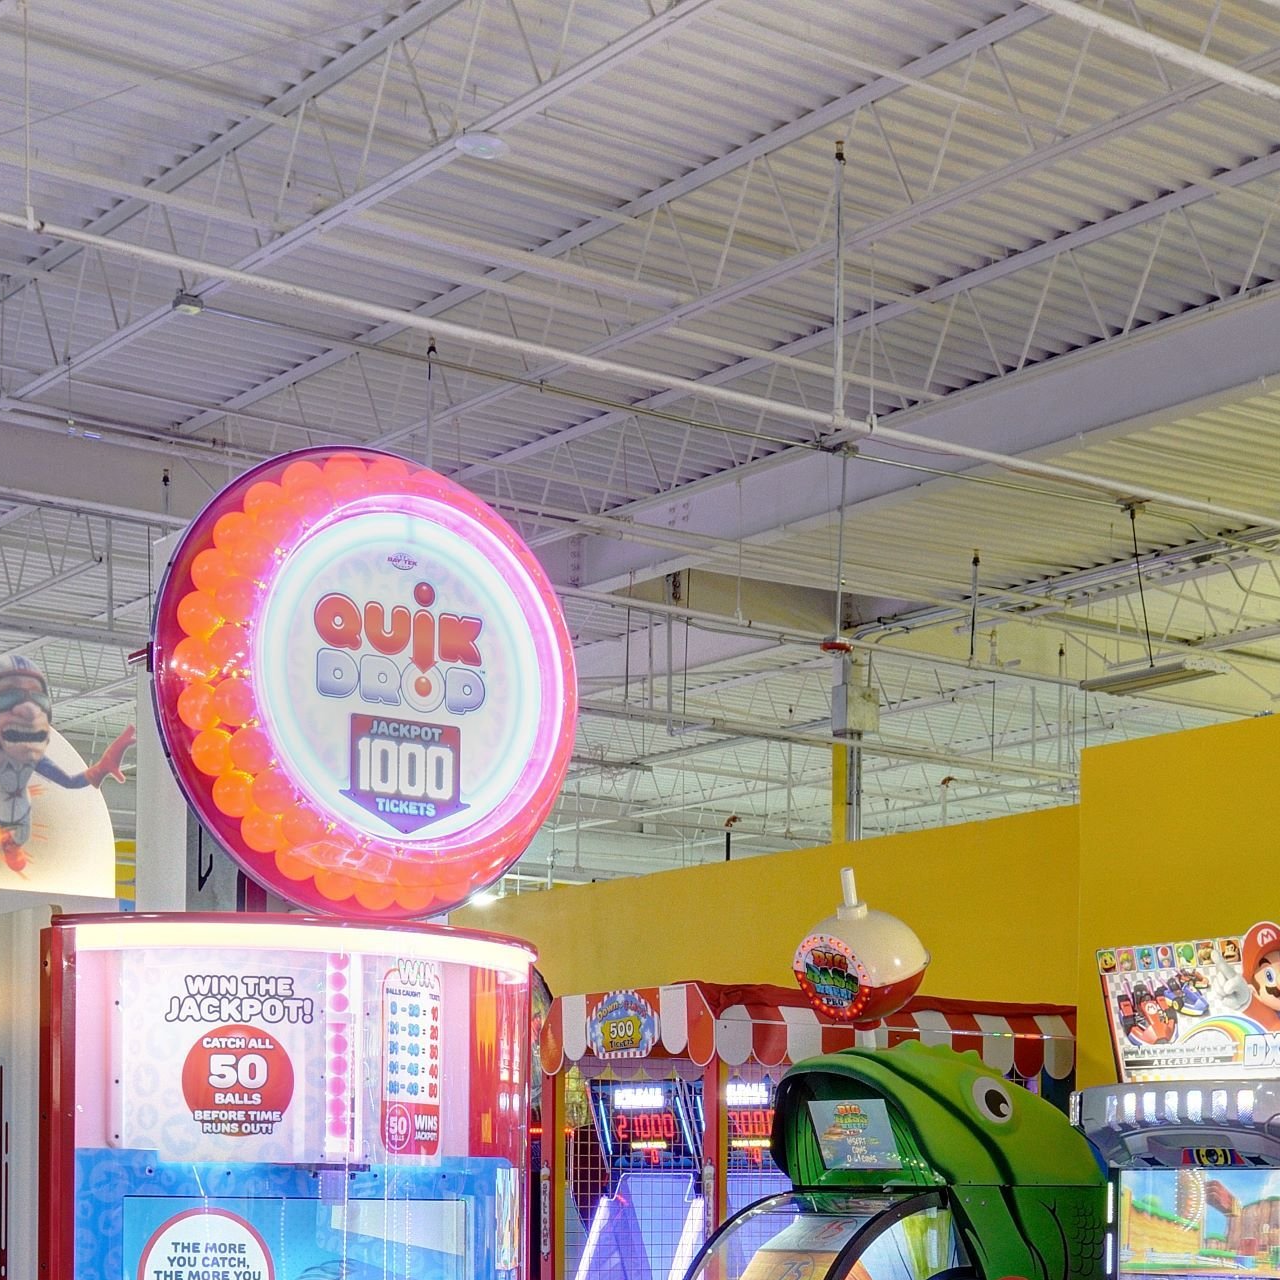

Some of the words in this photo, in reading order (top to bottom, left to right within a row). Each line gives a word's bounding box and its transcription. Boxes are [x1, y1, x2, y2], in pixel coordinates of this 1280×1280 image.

[316, 647, 486, 715] DROP
[371, 720, 443, 742] JACKPOT
[357, 738, 454, 801] 1000
[375, 797, 437, 818] TICKETS
[811, 949, 848, 972] BIG
[398, 958, 435, 989] WIN
[806, 963, 858, 993] BASS
[185, 975, 237, 998] WIN
[241, 976, 294, 998] THE
[386, 987, 401, 996] BALLS
[402, 989, 421, 998] CAUGHT
[165, 997, 314, 1024] JACKPOT!
[597, 1001, 619, 1022] Down
[610, 1020, 634, 1039] 500
[202, 1036, 245, 1050] CATCH
[247, 1036, 274, 1050] ALL
[208, 1053, 268, 1090] 50
[1153, 1058, 1195, 1066] ARCADE
[214, 1092, 262, 1106] BALLS
[194, 1110, 245, 1123] BEFORE
[247, 1110, 282, 1123] TIME
[389, 1116, 407, 1134] 50
[414, 1115, 438, 1131] WINS
[201, 1121, 239, 1135] RUNS
[241, 1121, 274, 1135] OUT!
[171, 1241, 200, 1254] THE
[204, 1242, 246, 1255] MORE
[168, 1256, 198, 1268] YOU
[201, 1256, 250, 1269] CATCH,
